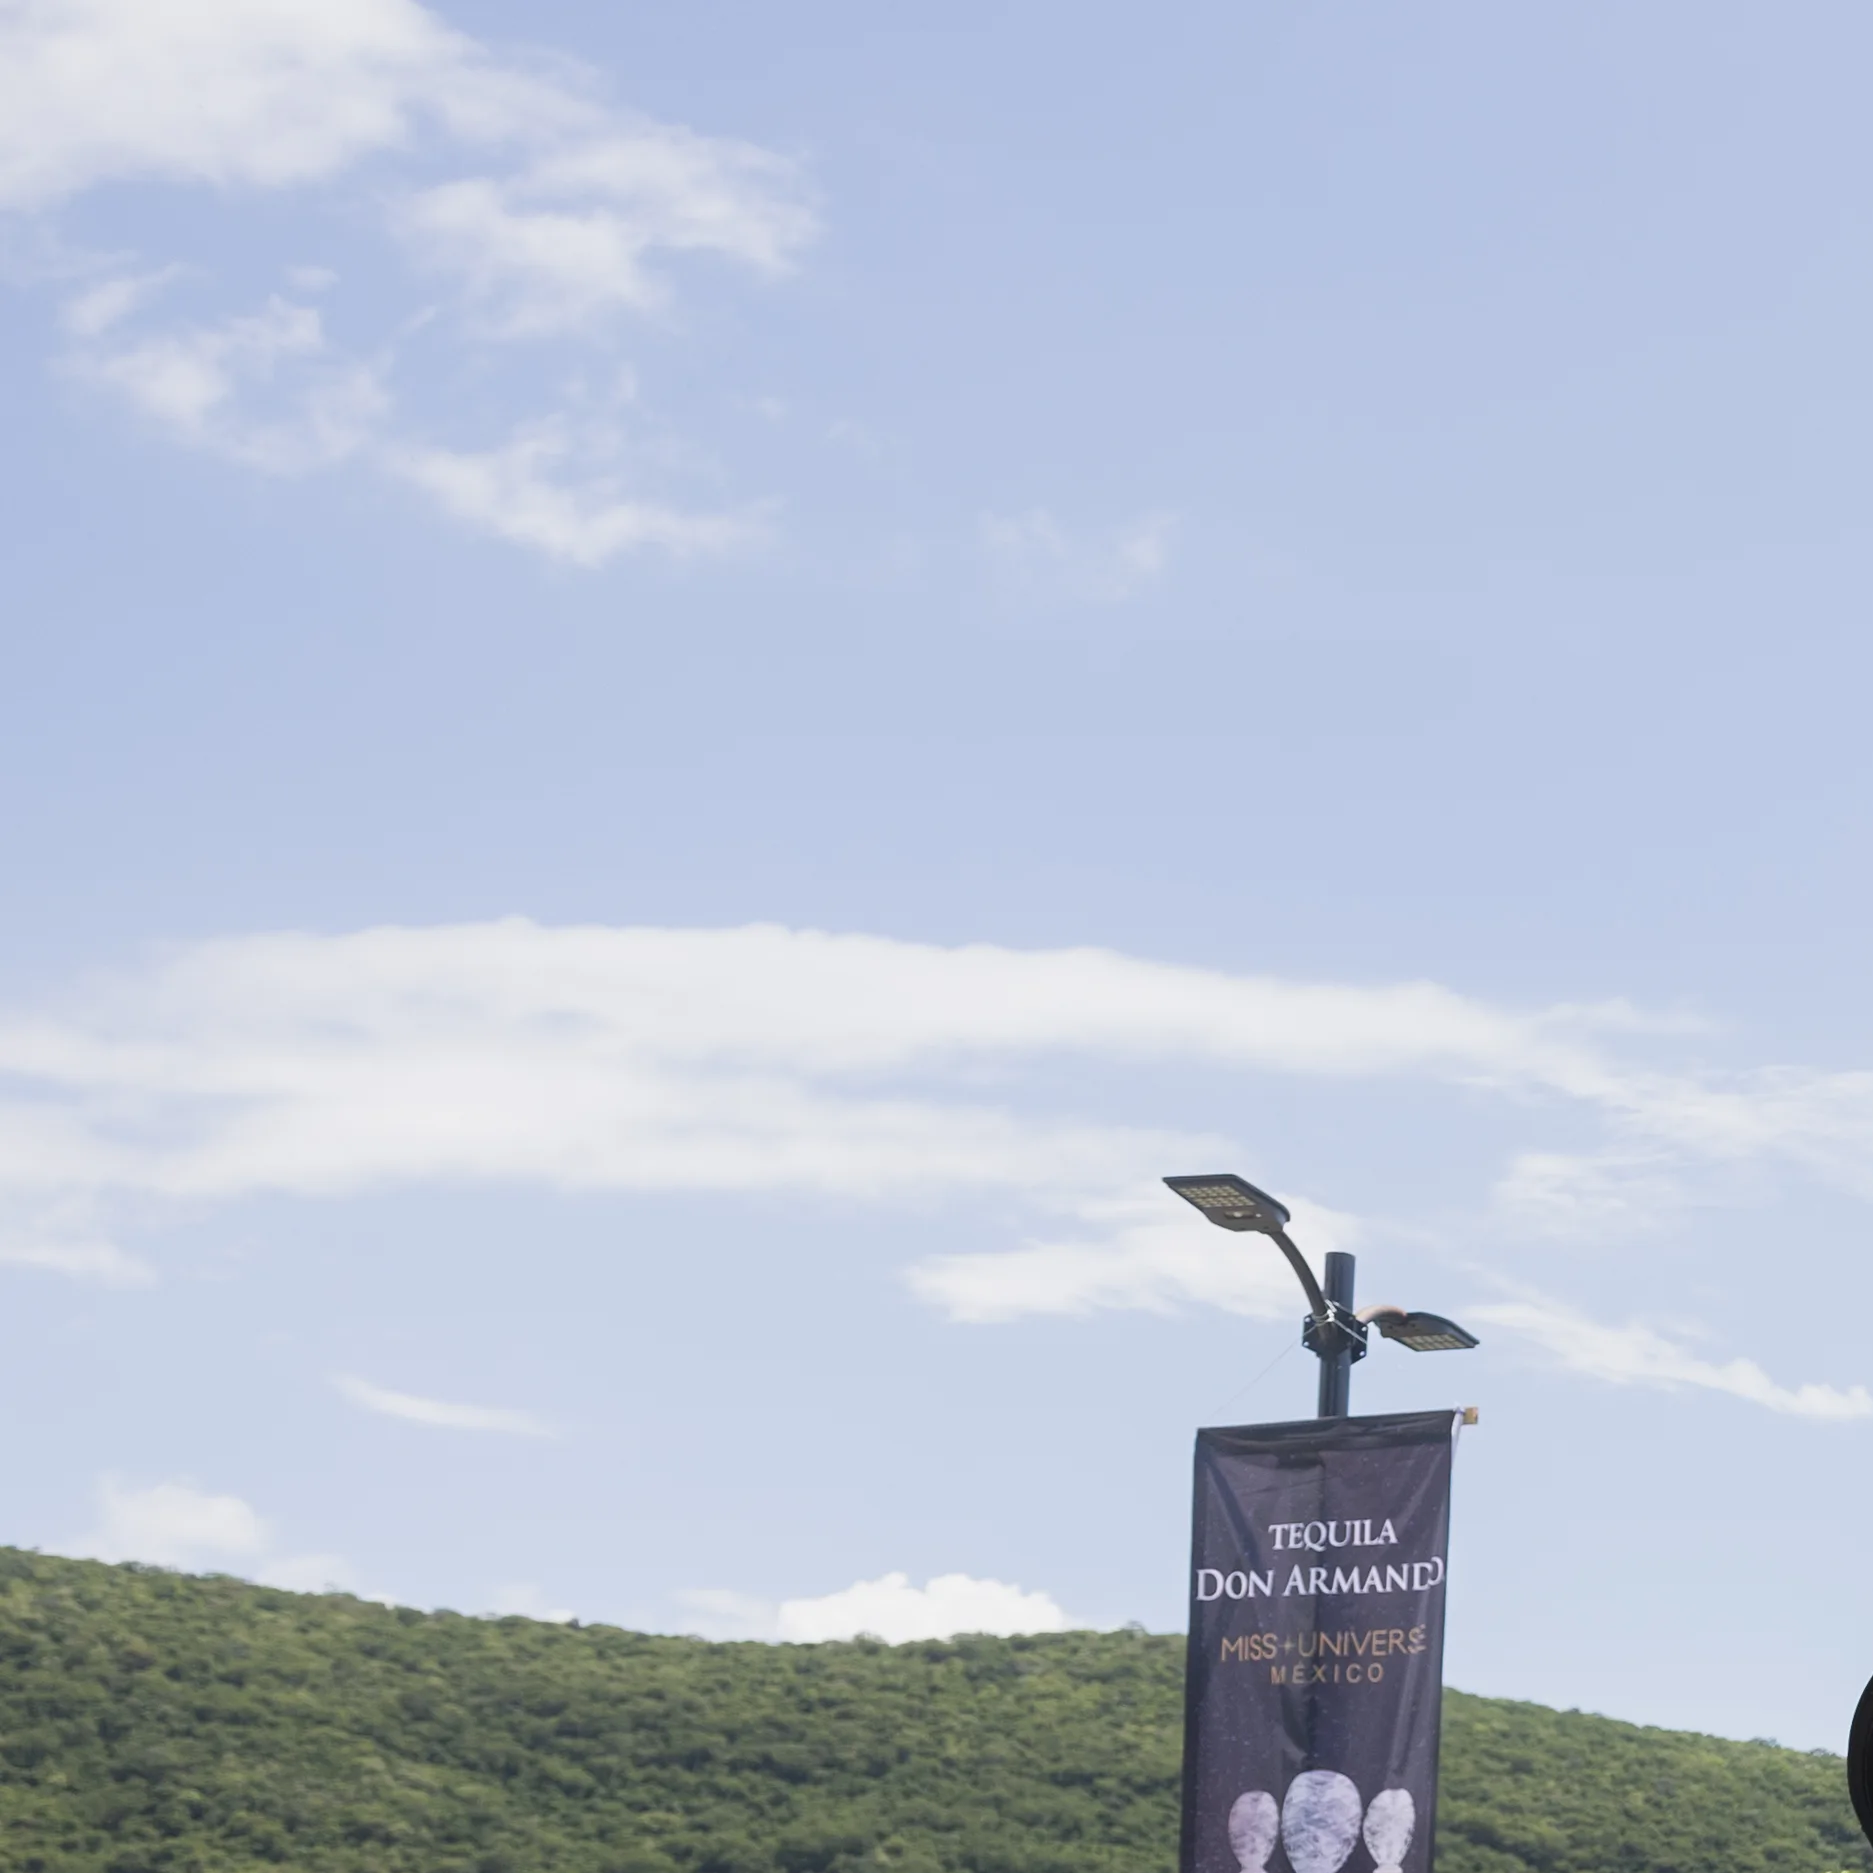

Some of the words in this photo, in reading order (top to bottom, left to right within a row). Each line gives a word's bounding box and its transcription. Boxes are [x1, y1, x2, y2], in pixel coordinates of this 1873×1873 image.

[1268, 1518, 1398, 1552] TEQUILA
[1196, 1568, 1275, 1601] DON
[1283, 1556, 1444, 1597] ARMANDO
[1220, 1632, 1278, 1662] MISS
